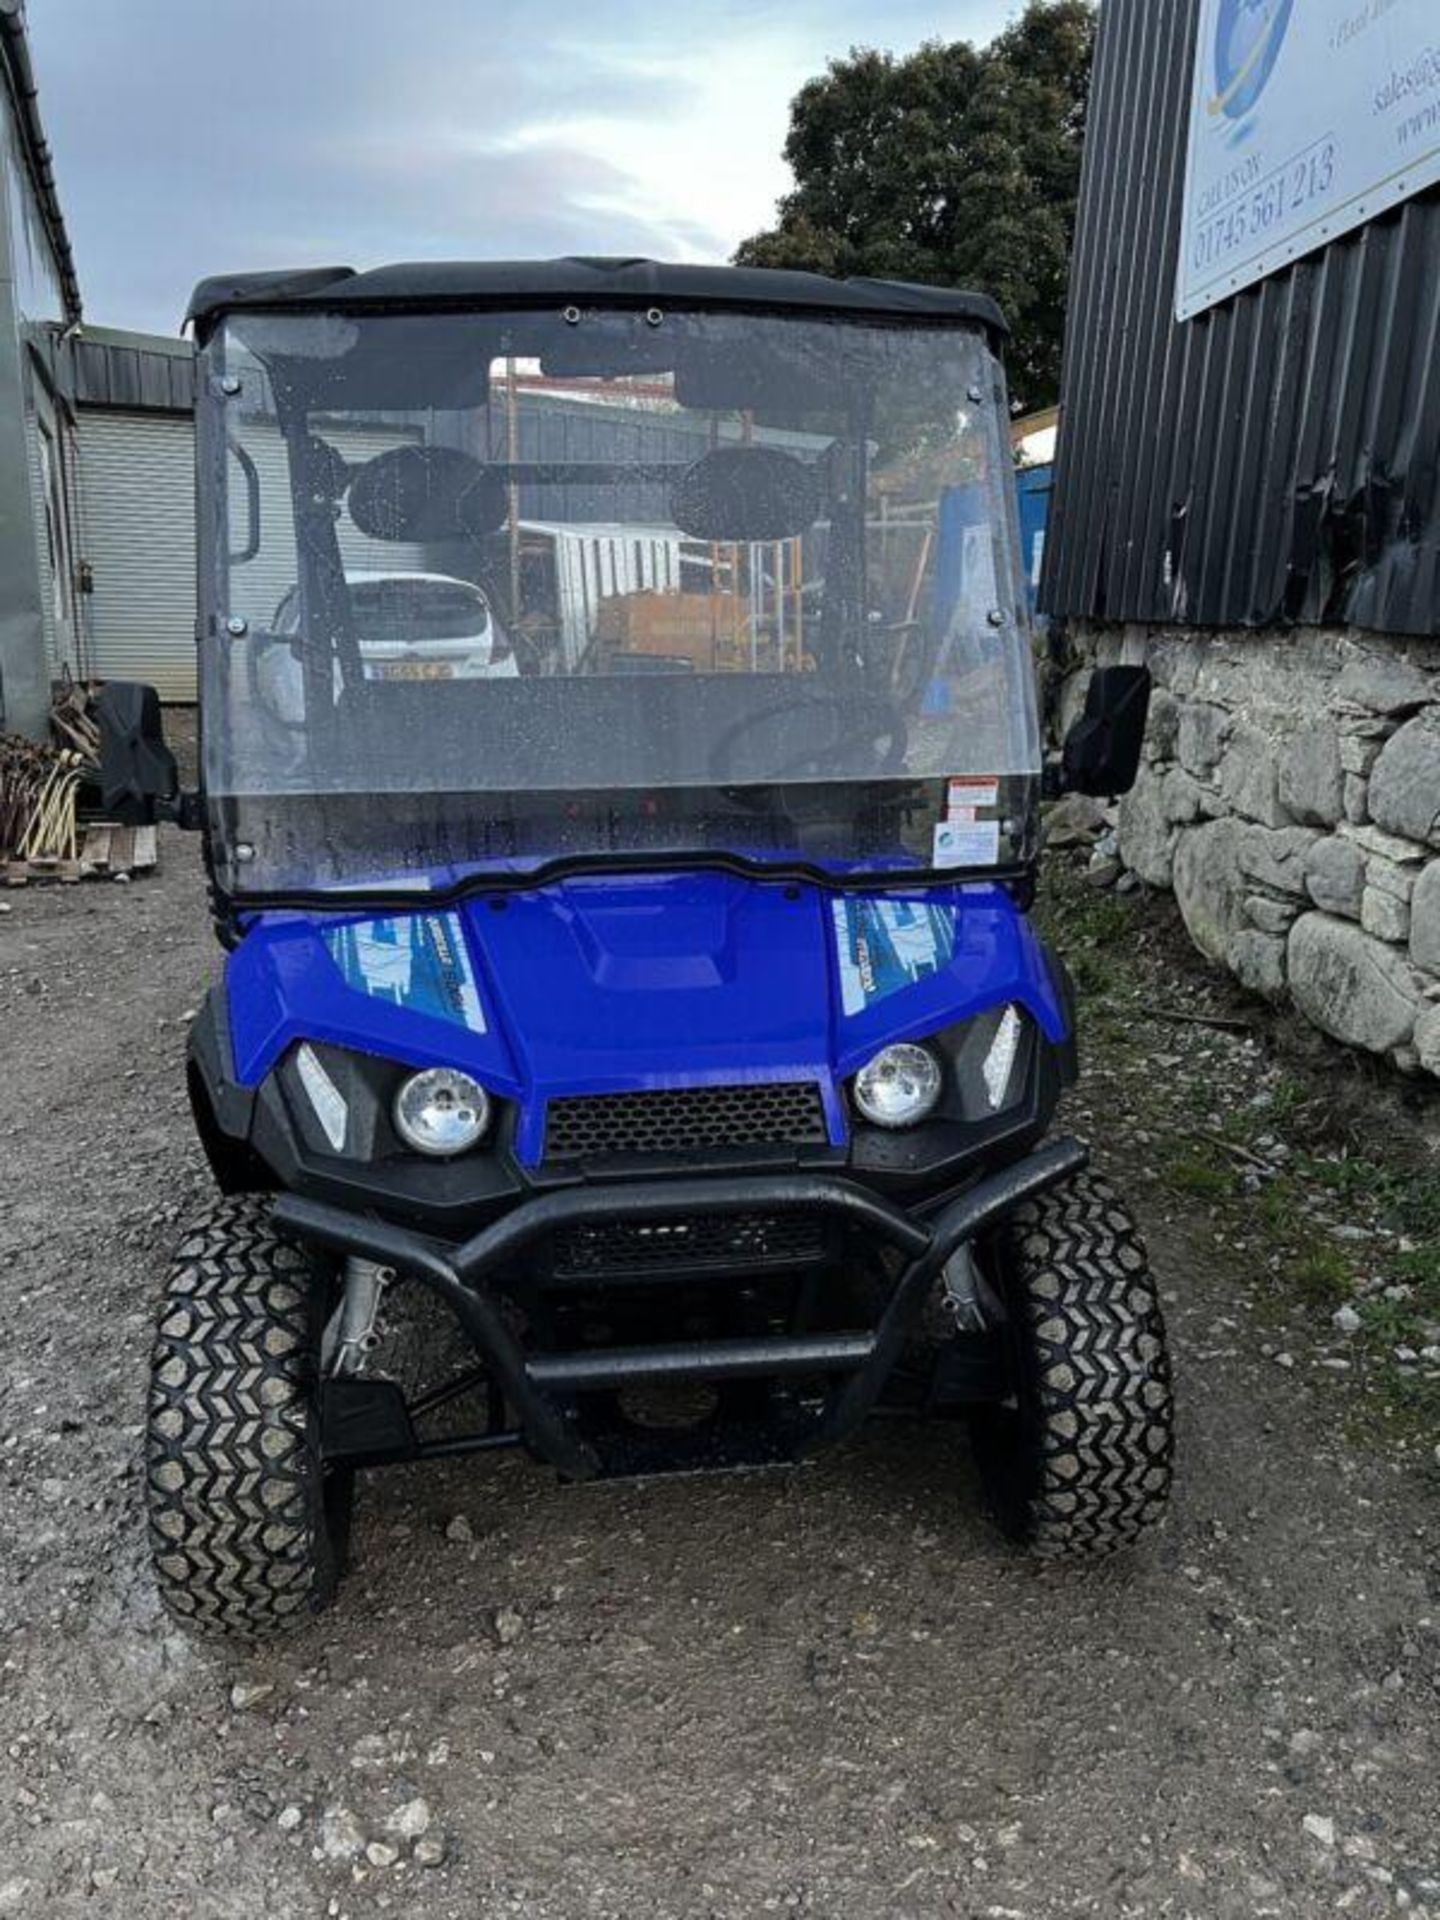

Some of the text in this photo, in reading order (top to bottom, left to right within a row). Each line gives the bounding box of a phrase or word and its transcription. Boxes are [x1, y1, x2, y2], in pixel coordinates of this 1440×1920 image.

[1195, 143, 1334, 269] 01745 561 213
[1198, 181, 1223, 217] CALL
